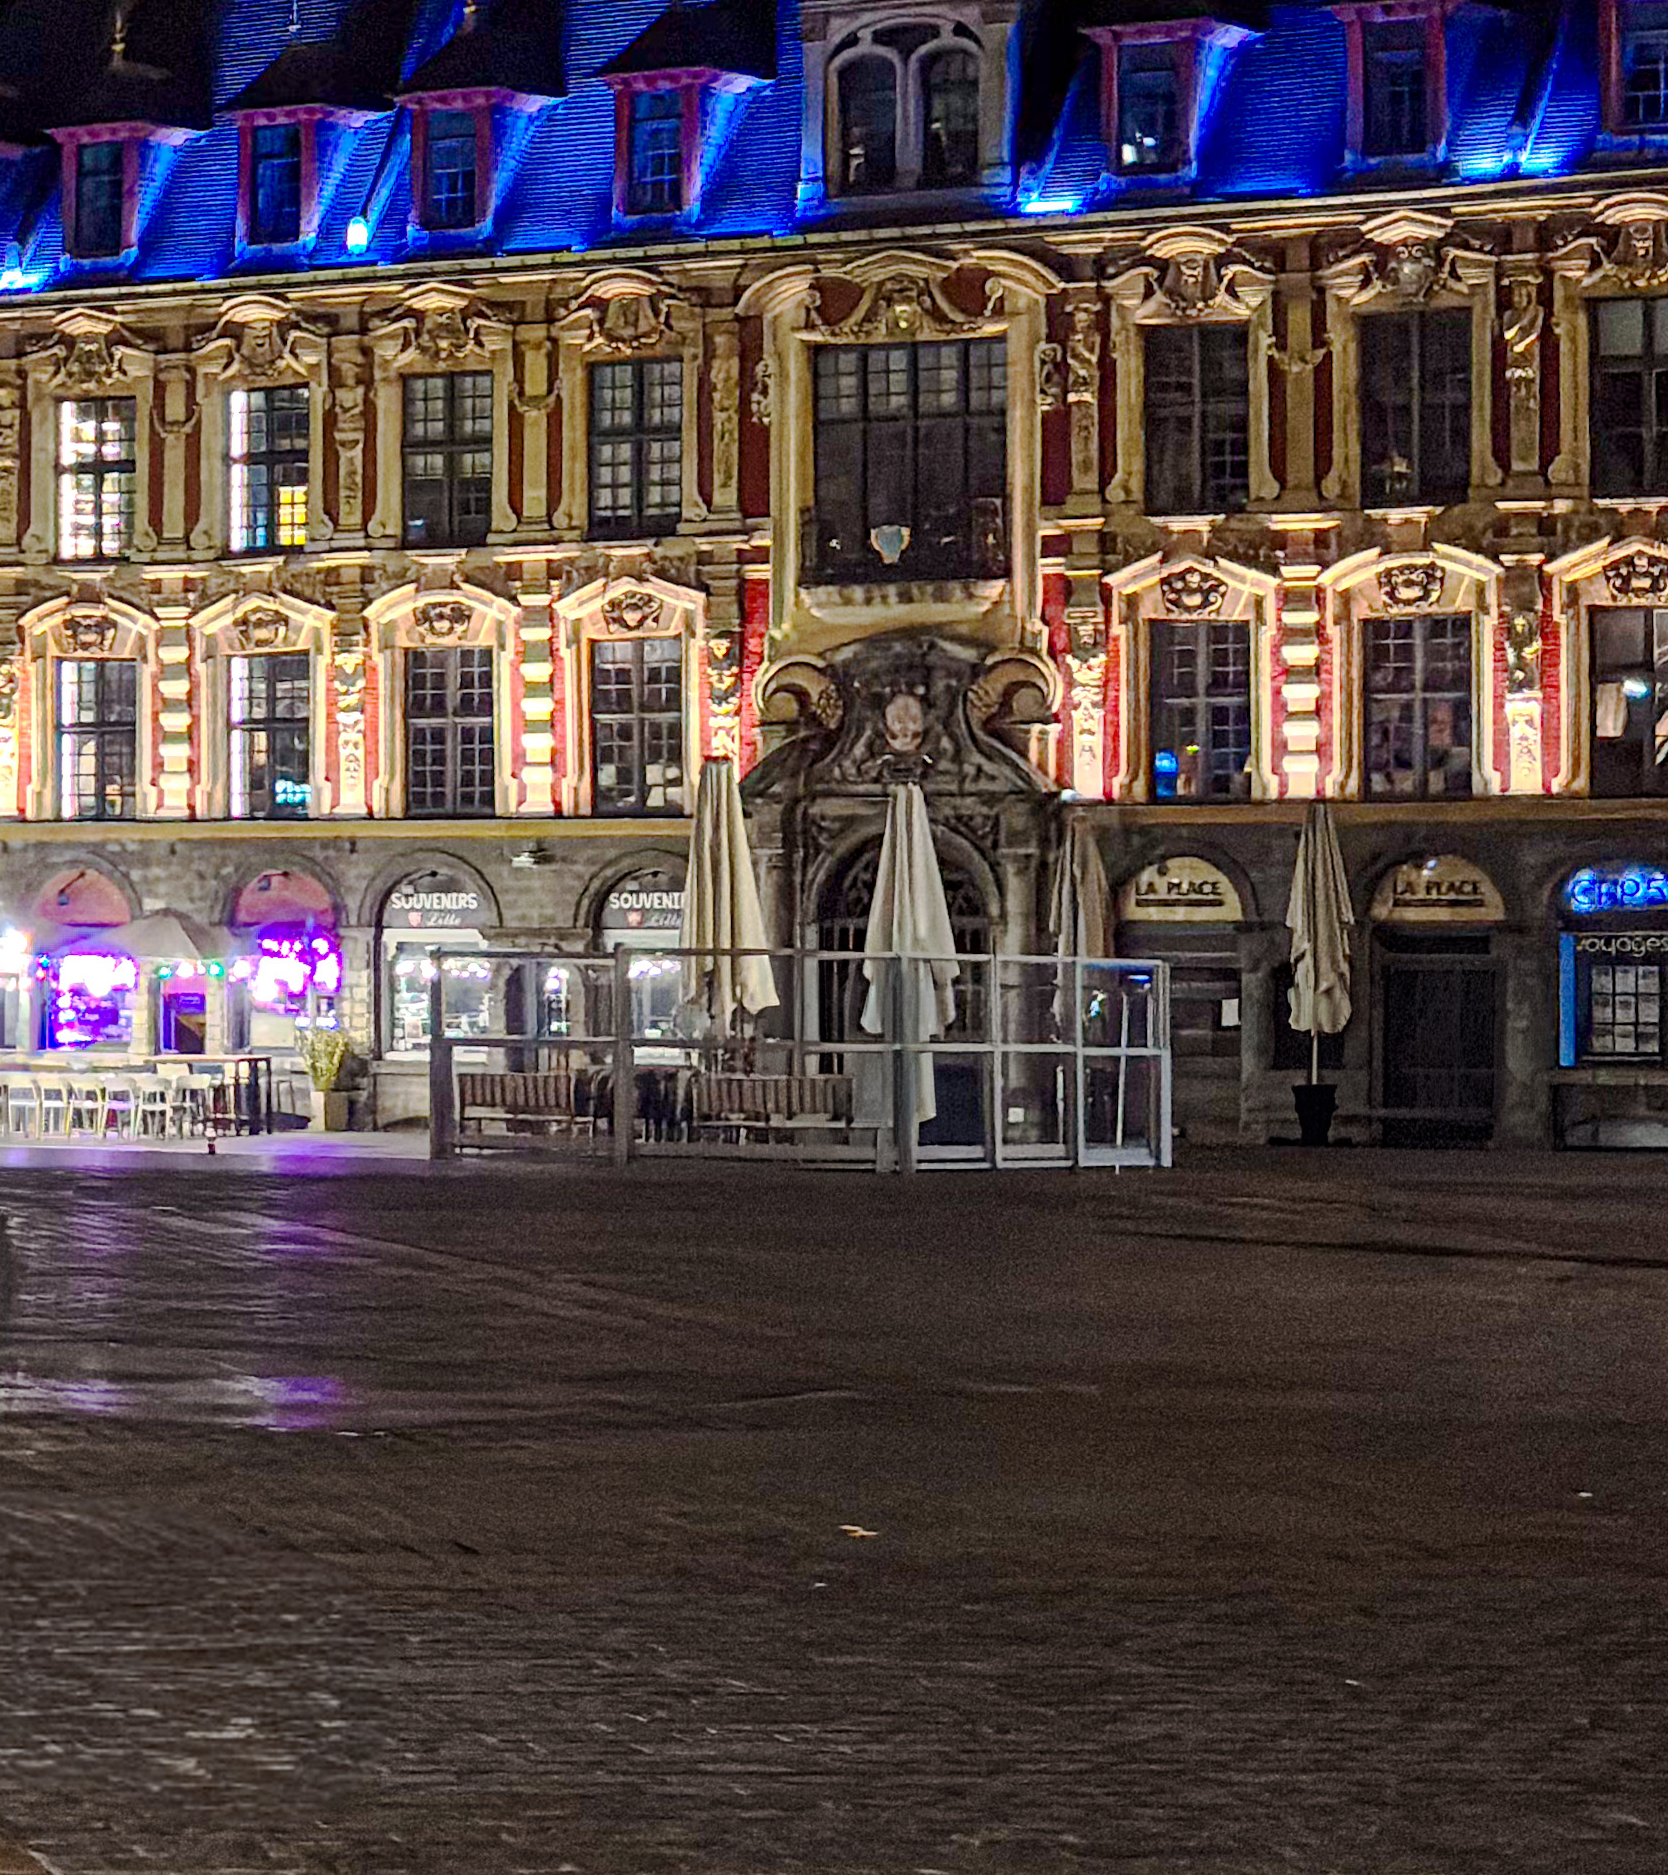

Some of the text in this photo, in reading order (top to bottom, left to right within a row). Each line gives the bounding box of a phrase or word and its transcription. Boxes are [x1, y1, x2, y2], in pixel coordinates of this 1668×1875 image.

[1135, 881, 1223, 896] LA PLACE
[1393, 879, 1484, 896] LA PLACE
[390, 891, 479, 910] SOUVENIRS
[608, 891, 684, 910] SOUVENI
